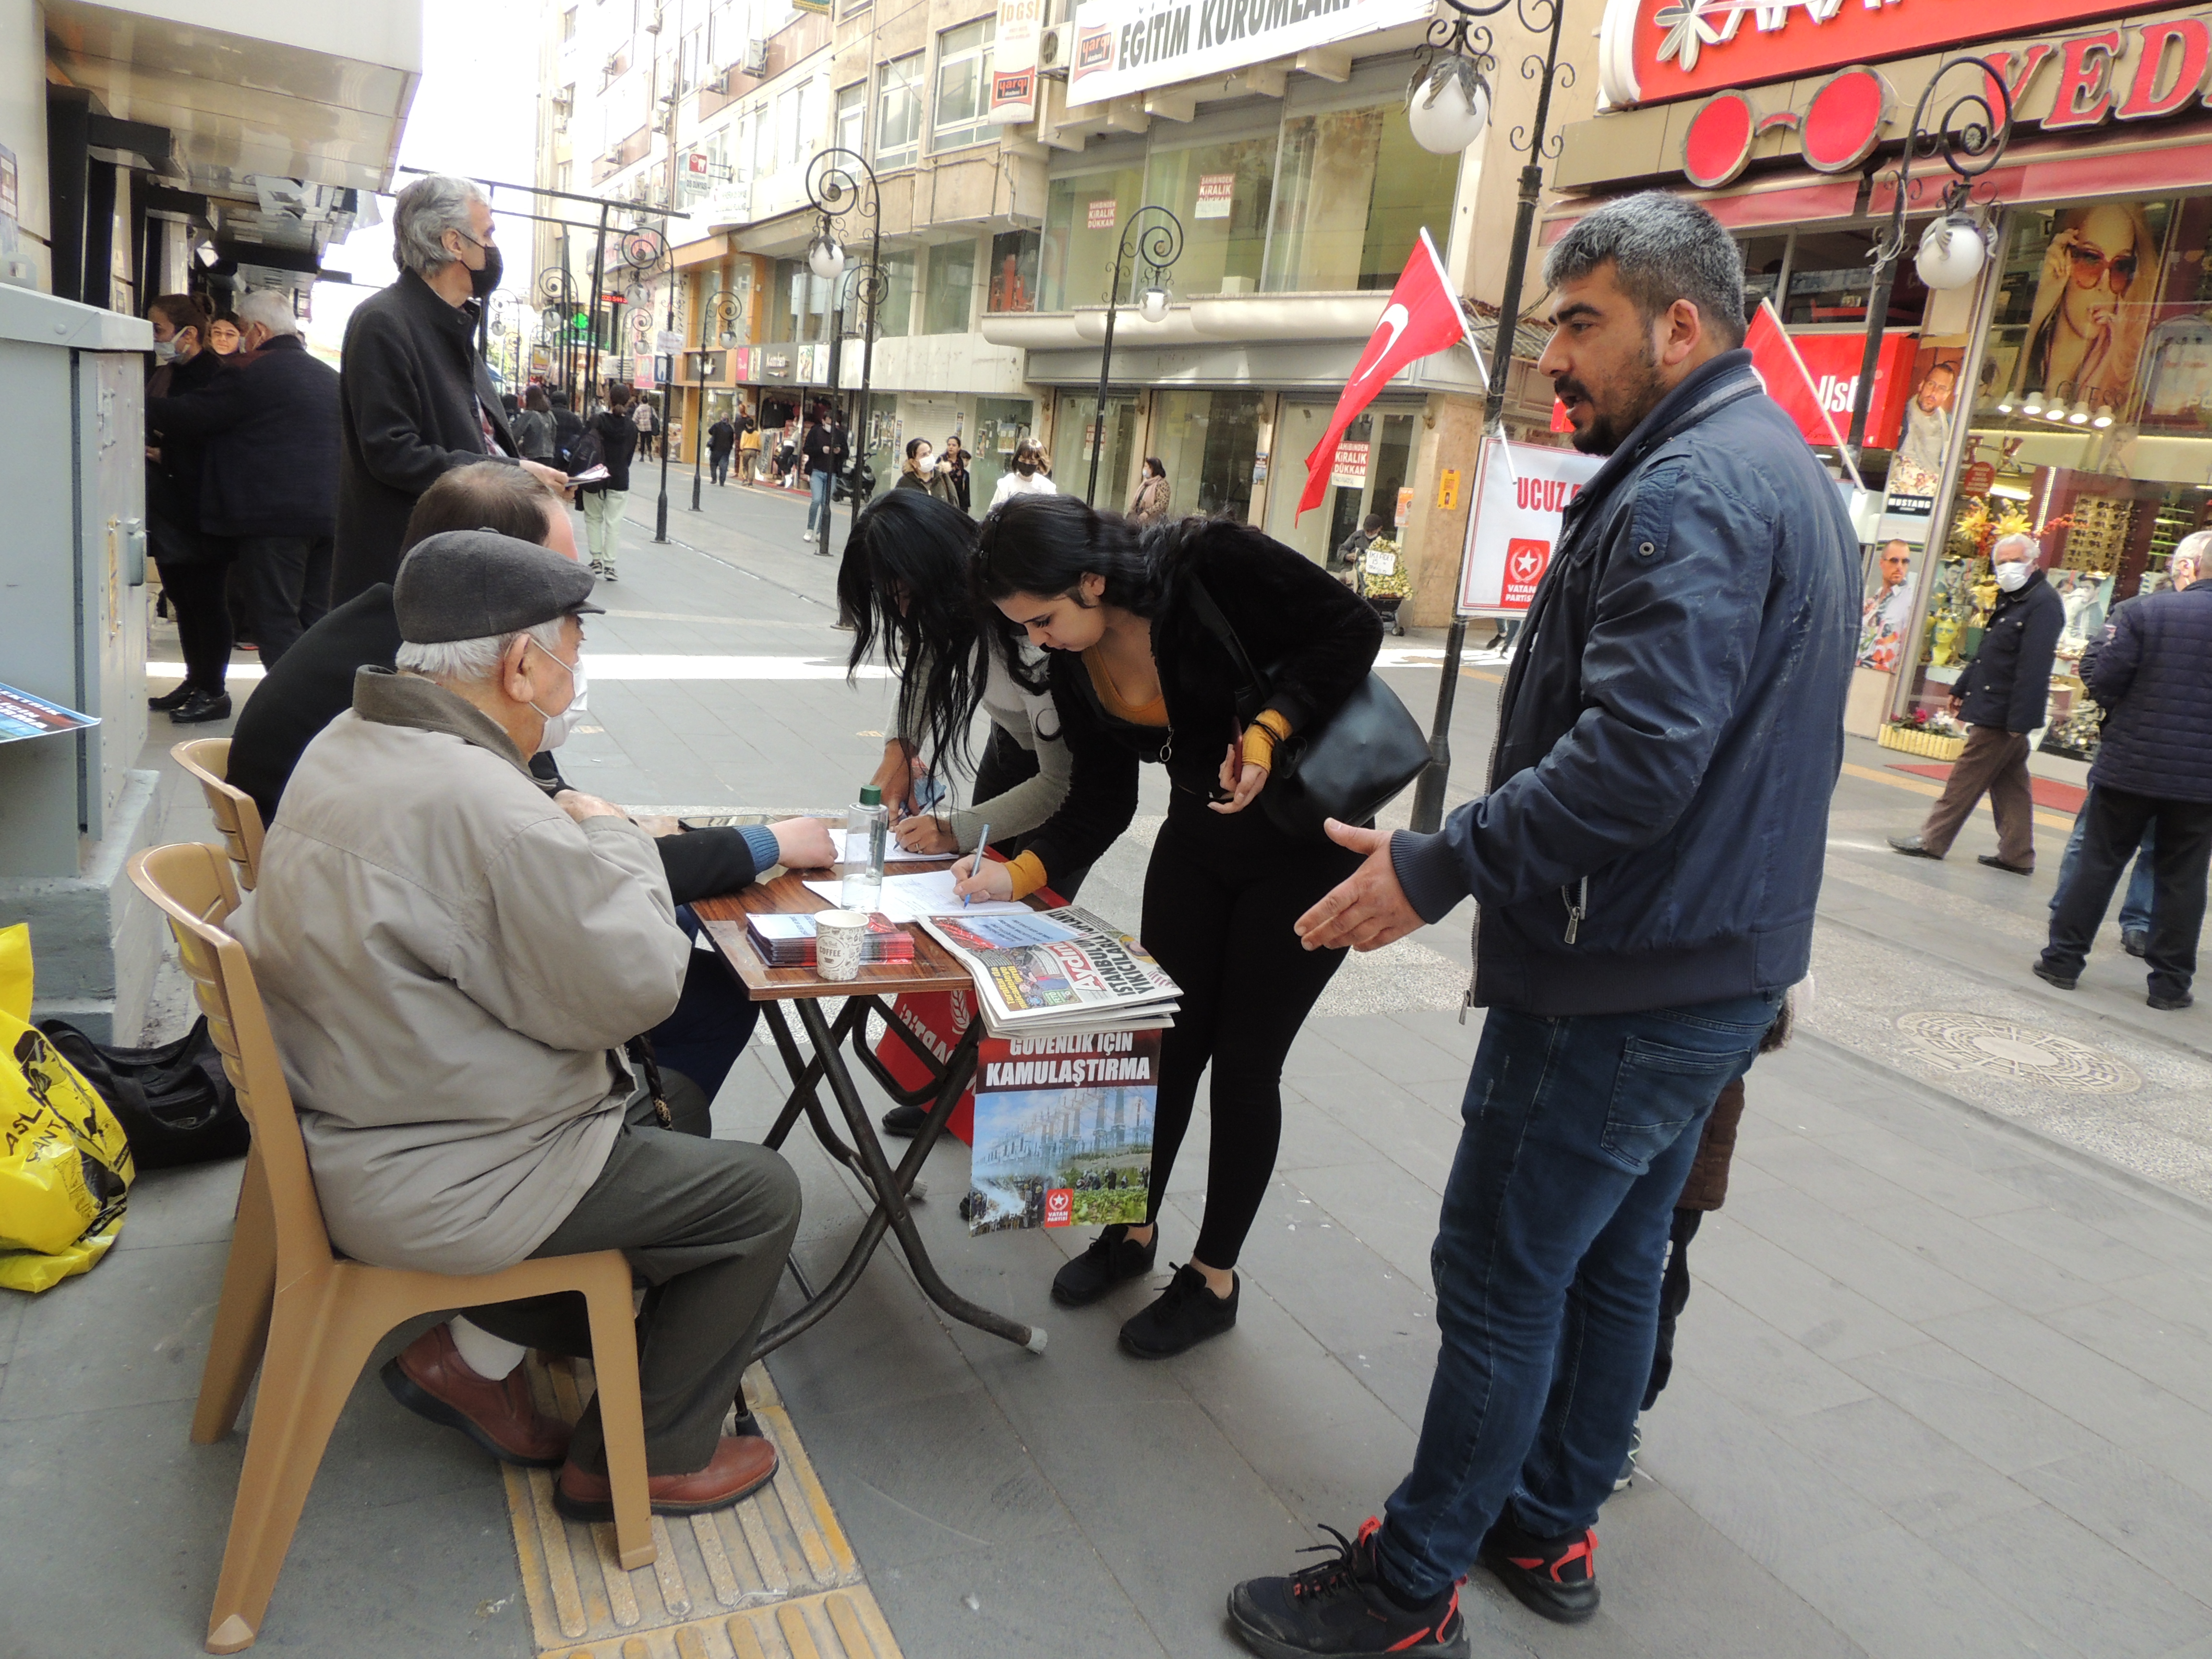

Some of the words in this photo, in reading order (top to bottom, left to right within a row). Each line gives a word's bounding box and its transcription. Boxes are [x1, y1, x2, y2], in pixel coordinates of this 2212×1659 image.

[1118, 0, 1191, 71] EĞİTİM
[1982, 16, 2212, 138] VED
[1199, 184, 1231, 195] KİRALIK
[1818, 375, 1875, 413] Ust
[1334, 463, 1366, 475] DÜKKAN
[1335, 451, 1367, 464] KİRALIK
[1517, 477, 1567, 513] UCUZ
[1888, 498, 1931, 509] MUSTANG
[1507, 584, 1537, 594] VATAN
[0, 688, 62, 715] EKTRİK
[0, 706, 48, 729] RMA
[819, 946, 842, 957] COFFEE
[986, 1057, 1150, 1087] KAMULAŞTIRMA
